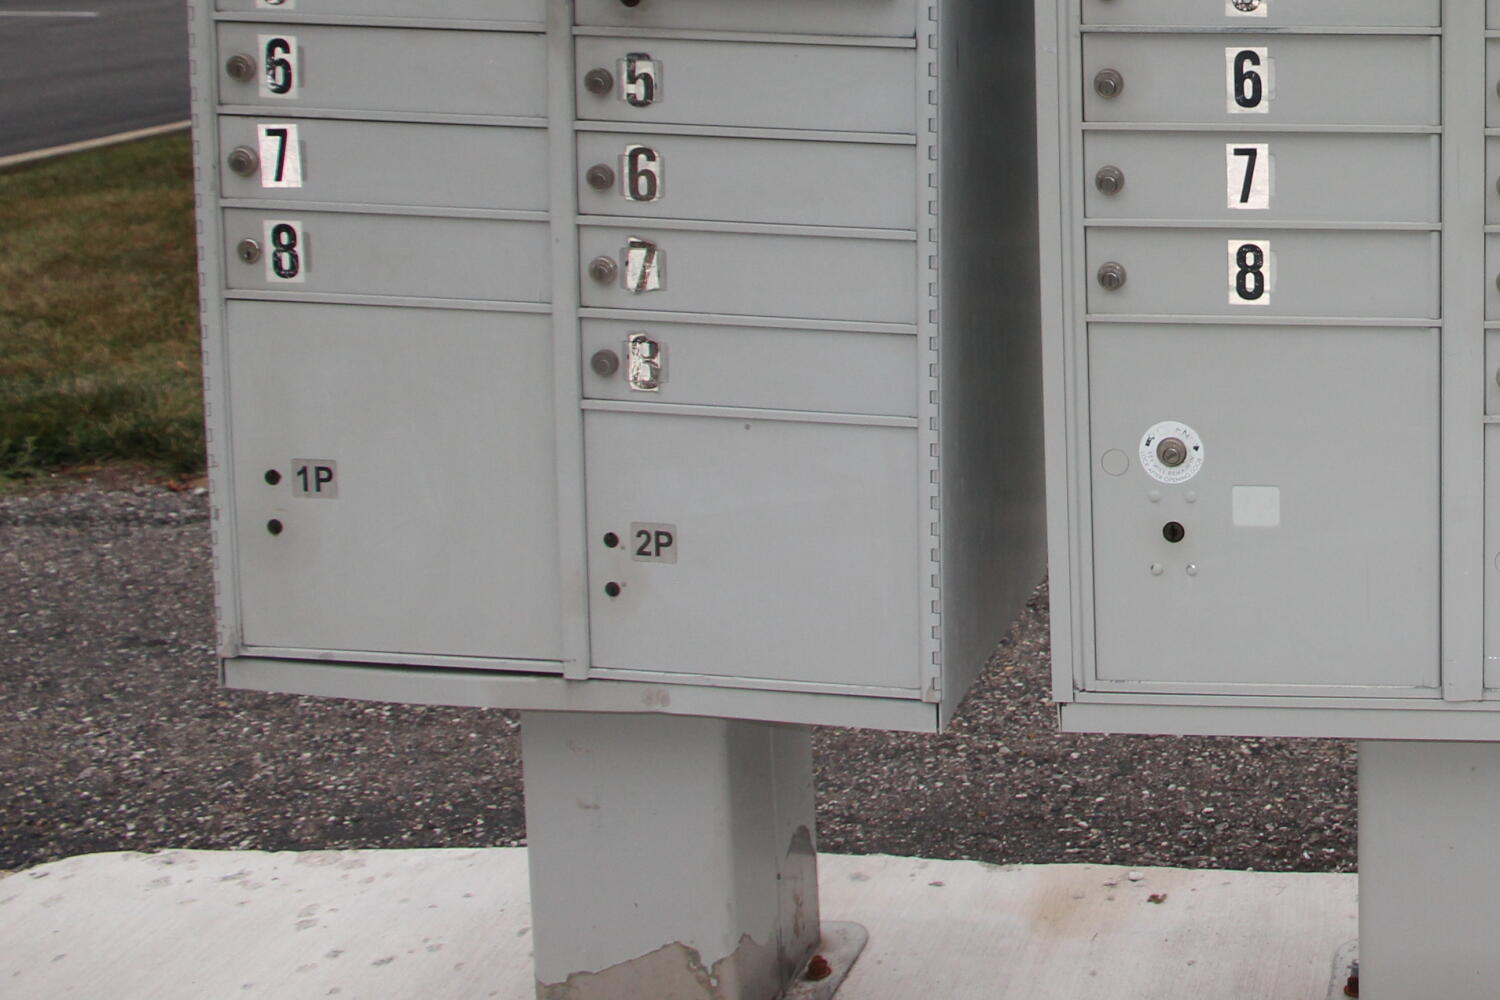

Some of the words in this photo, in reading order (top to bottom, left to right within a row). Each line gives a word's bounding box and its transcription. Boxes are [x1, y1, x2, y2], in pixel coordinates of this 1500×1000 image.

[265, 38, 292, 95] 6
[625, 51, 655, 109] 5
[1233, 49, 1263, 109] 6
[265, 128, 288, 182] 7
[628, 146, 657, 202] 6
[1233, 147, 1258, 204] 7
[271, 223, 300, 279] 8
[626, 239, 658, 293] 7
[1235, 243, 1265, 301] 8
[297, 465, 333, 492] 1P
[636, 529, 673, 557] 2P
